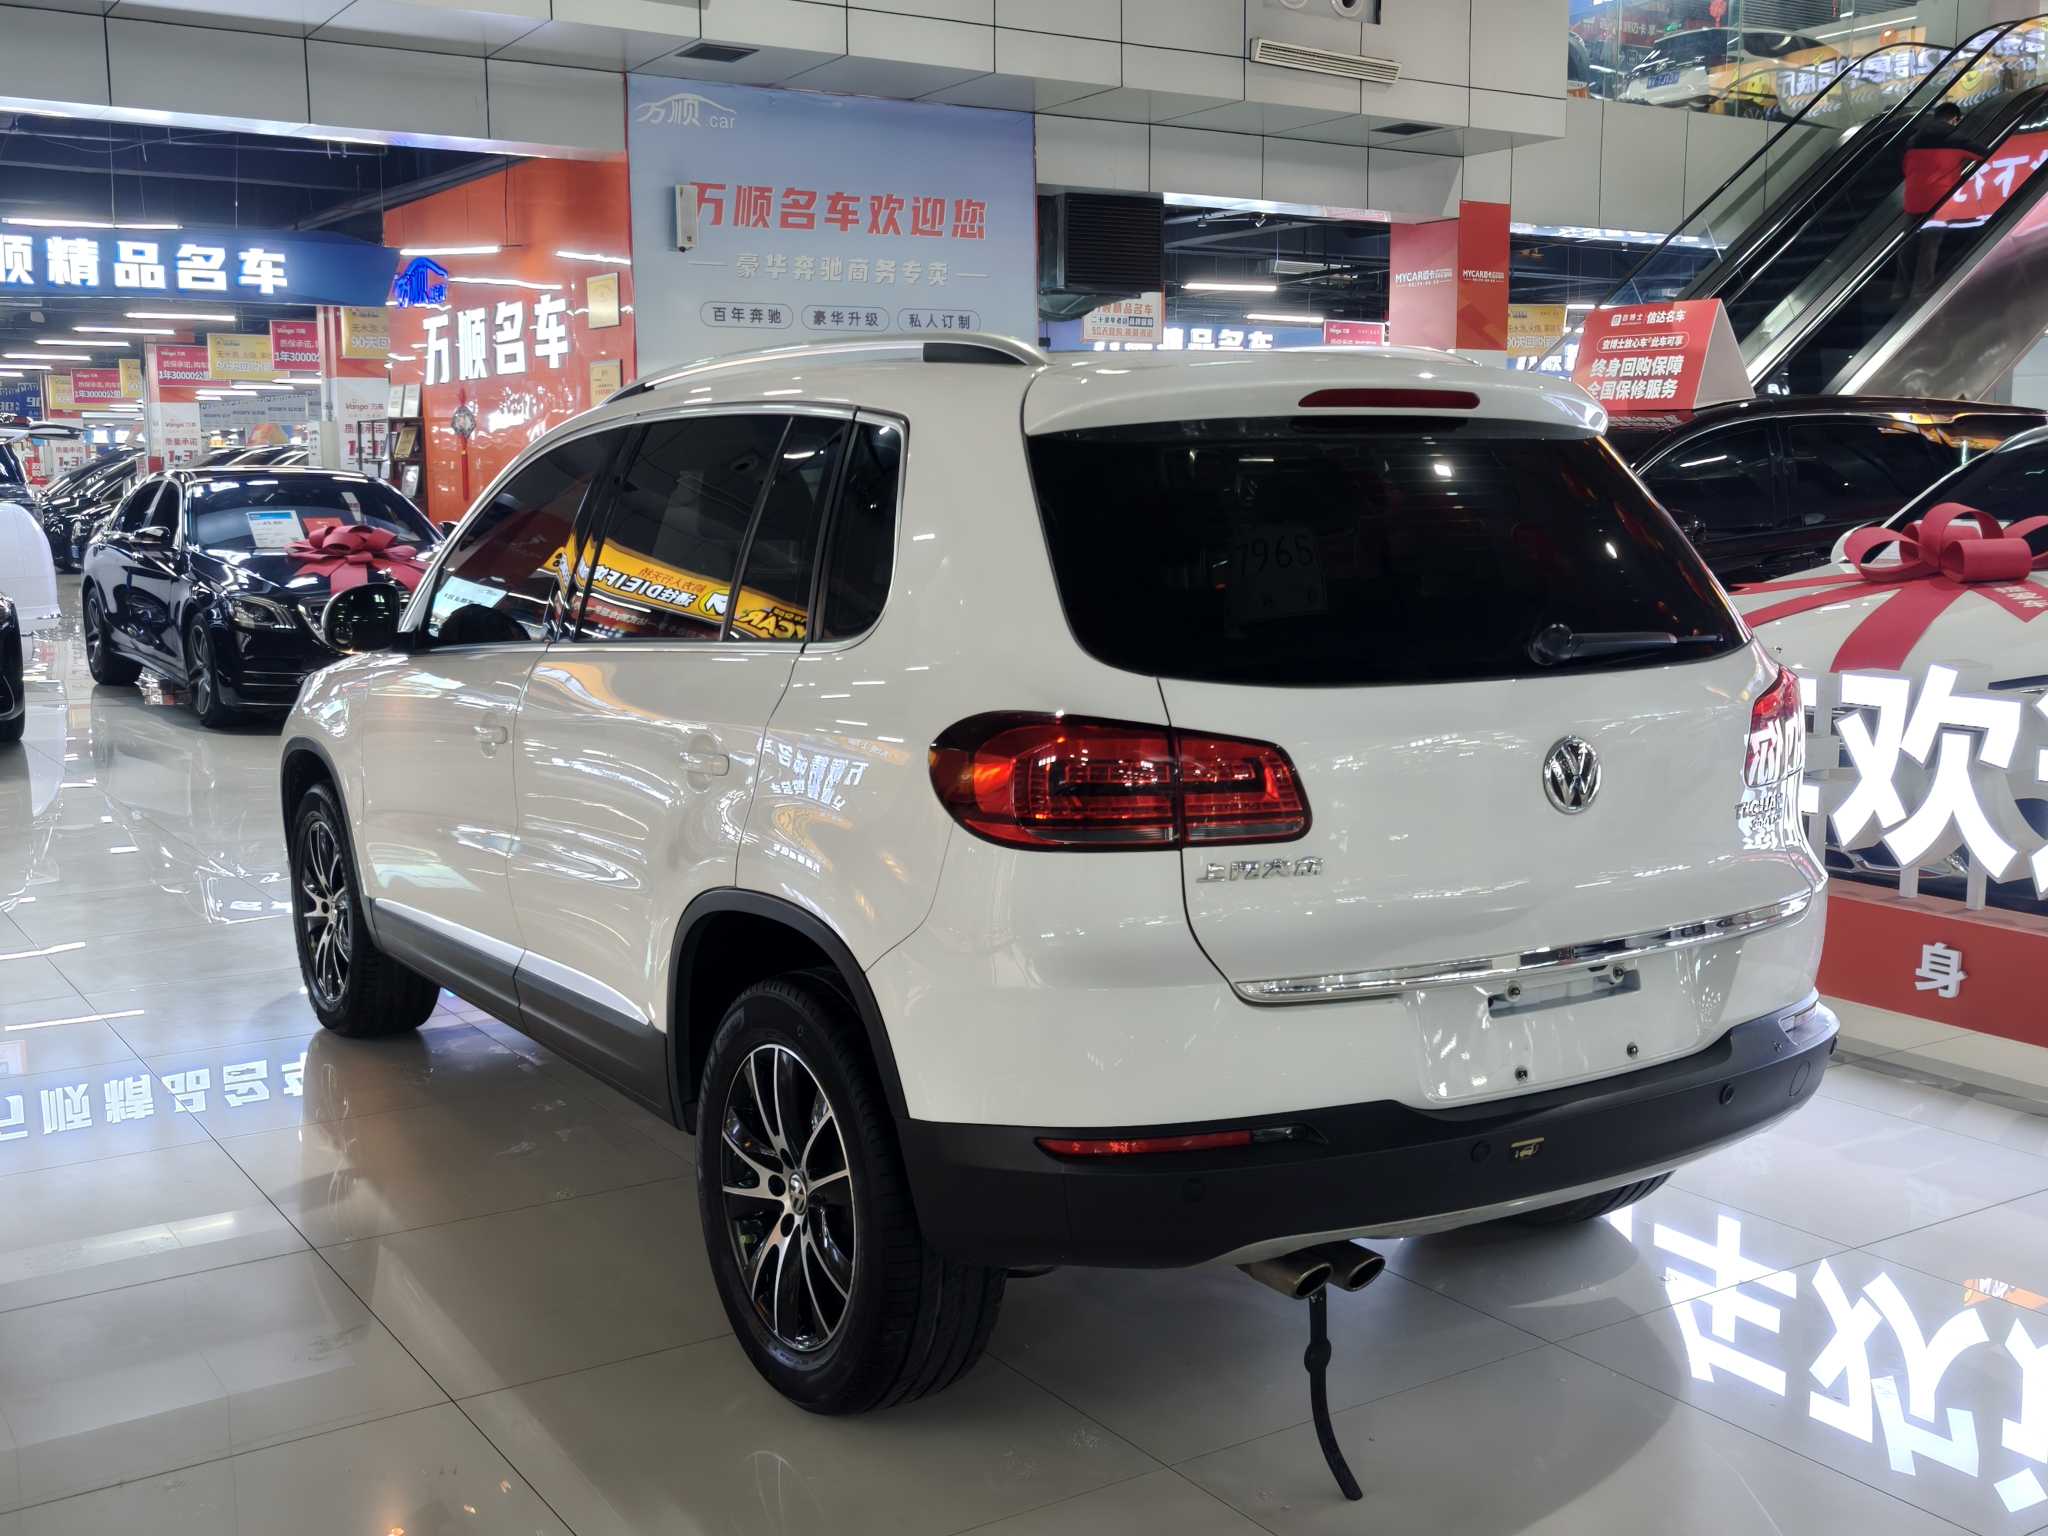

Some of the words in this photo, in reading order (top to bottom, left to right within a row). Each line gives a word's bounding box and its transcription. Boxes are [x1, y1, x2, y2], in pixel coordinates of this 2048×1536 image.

[689, 181, 986, 241] 万顺名车欢迎您
[735, 253, 949, 286] 豪华奔驰商务专卖
[713, 307, 782, 325] 百年奔驰
[813, 310, 880, 328] 豪华升级
[908, 313, 971, 330] 私人订制
[423, 294, 569, 386] 万顺名车
[1590, 355, 1684, 377] 终身回购保障
[1587, 379, 1678, 400] 全国保修服务
[1914, 942, 1967, 999] 身
